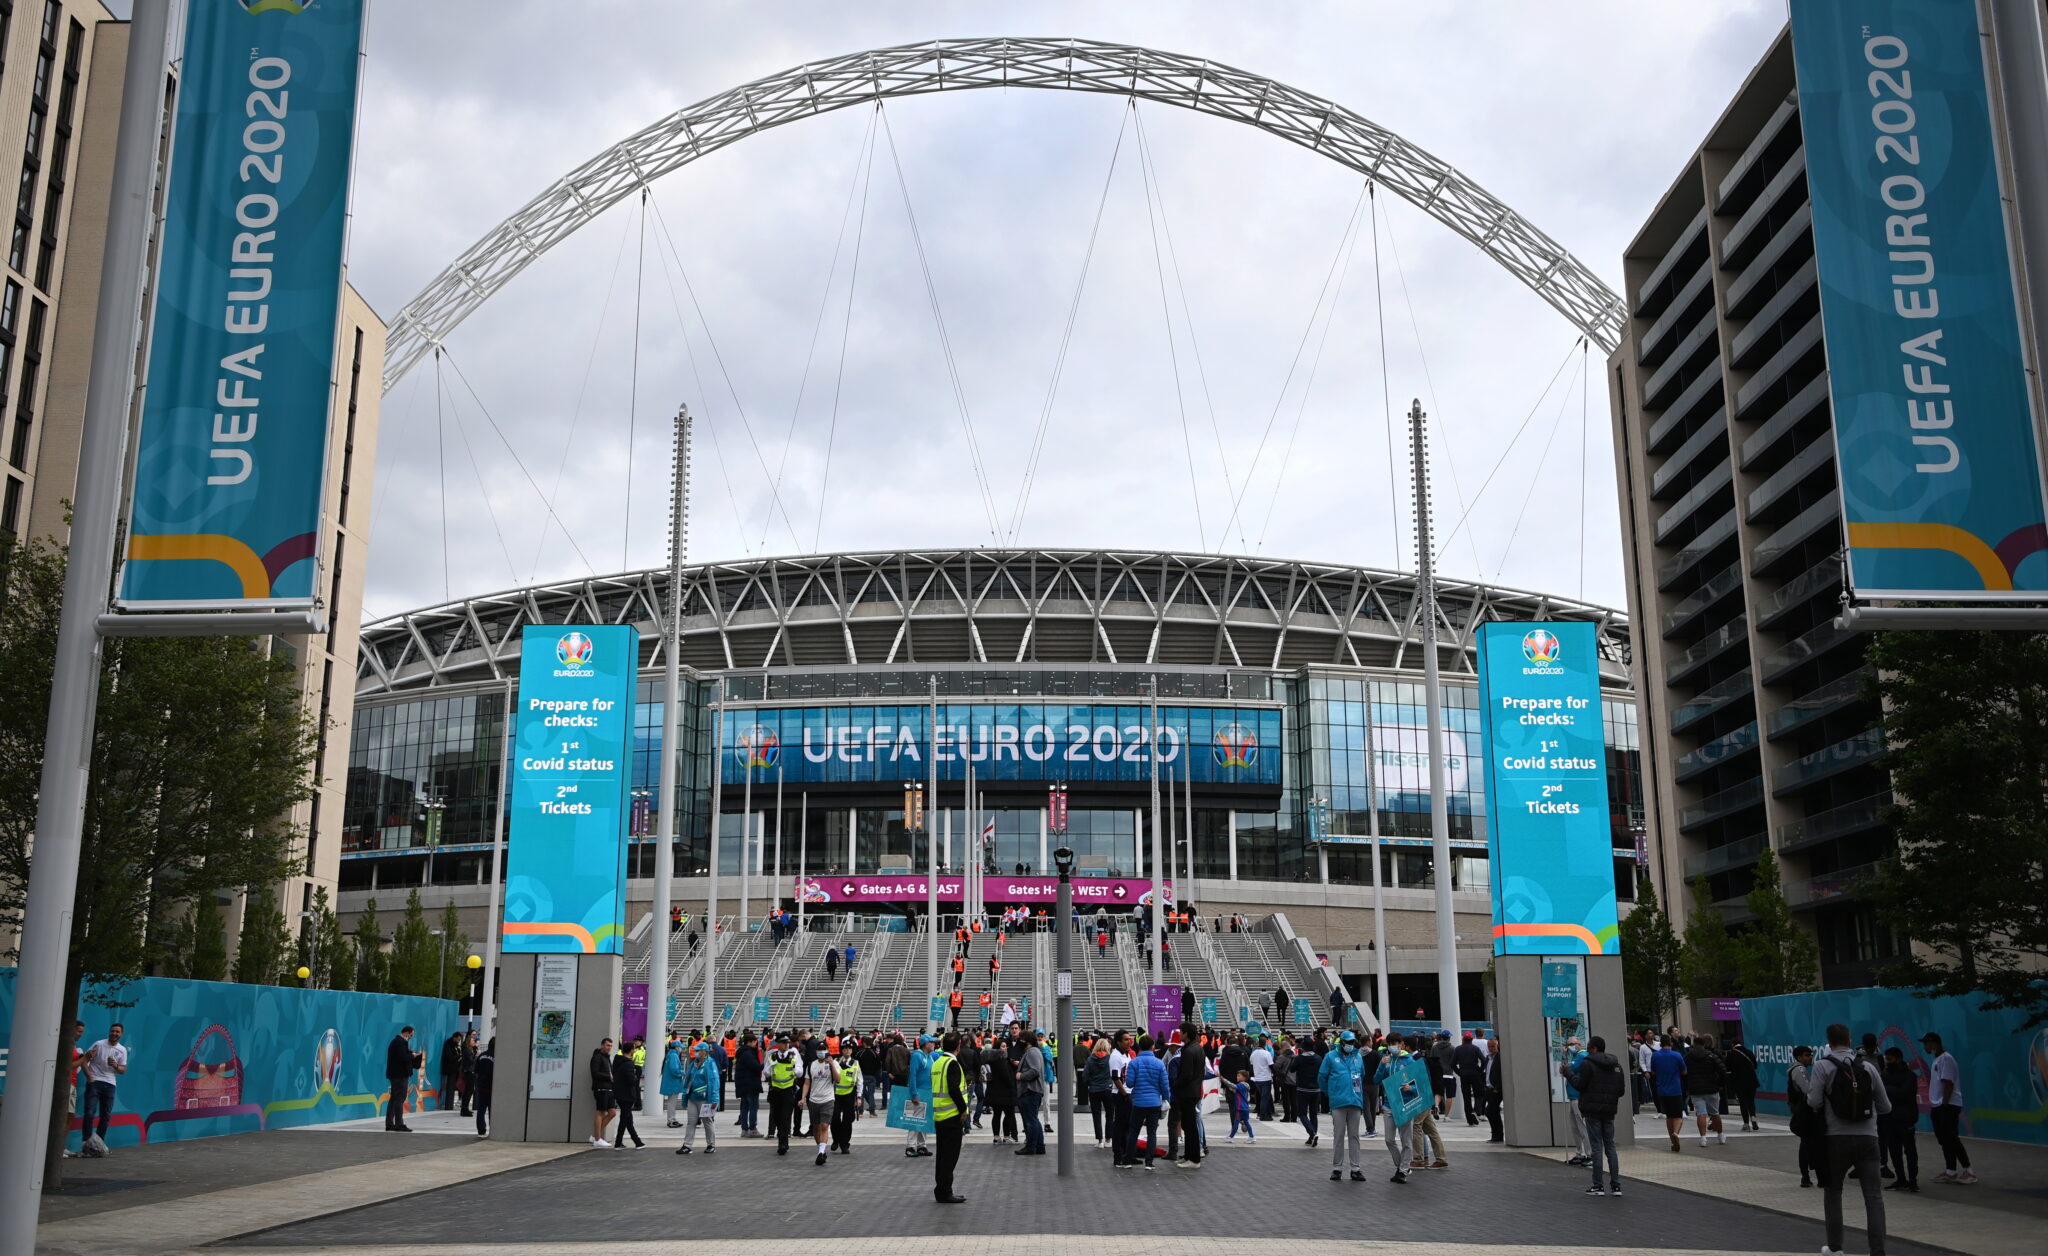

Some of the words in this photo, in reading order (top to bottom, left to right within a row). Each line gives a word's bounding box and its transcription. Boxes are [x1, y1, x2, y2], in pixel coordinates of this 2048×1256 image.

[1863, 34, 1921, 165] 2020
[239, 56, 292, 184] 2020
[1880, 175, 1939, 319] EURO
[224, 193, 279, 334] EURO
[1900, 328, 1960, 474] UEFA
[207, 343, 265, 486] UEFA
[530, 698, 588, 713] Prepare
[592, 698, 614, 711] for
[1503, 697, 1562, 711] Prepare
[1566, 696, 1589, 708] for
[544, 714, 598, 727] checks:
[1519, 712, 1575, 725] checks:
[561, 742, 579, 754] 1st
[804, 726, 921, 763] UEFA
[935, 725, 1055, 761] EURO
[1063, 725, 1179, 763] 2020
[1541, 741, 1558, 753] 1st
[523, 757, 565, 770] Covid
[568, 758, 614, 770] status
[1503, 757, 1546, 769] Covid
[1550, 757, 1597, 769] status
[556, 785, 578, 797] 2nd
[1542, 785, 1563, 797] 2nd
[540, 801, 592, 814] Tickets
[1526, 801, 1580, 814] Tickets
[860, 884, 892, 895] Gates
[894, 884, 916, 895] A-G
[918, 884, 927, 894] &
[1008, 884, 1041, 896] Gates
[1077, 886, 1109, 897] WEST
[1776, 1045, 1797, 1064] EUR
